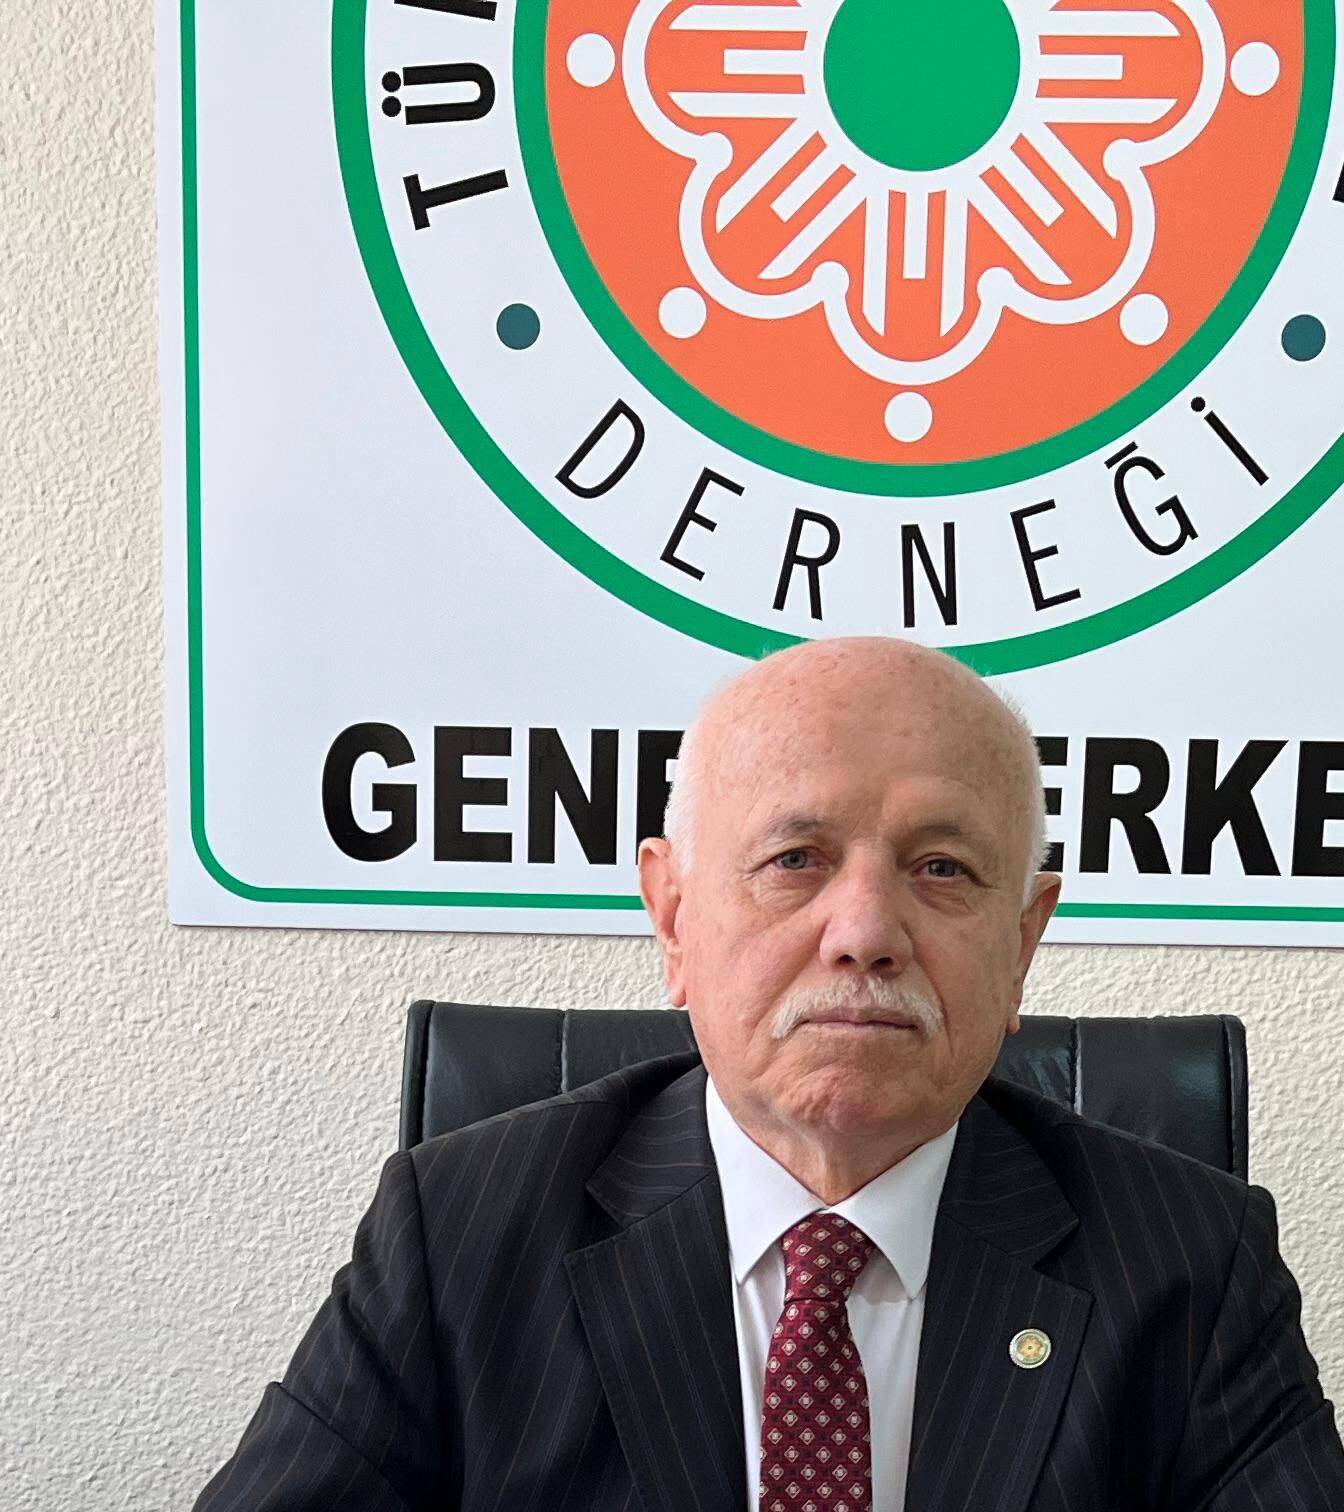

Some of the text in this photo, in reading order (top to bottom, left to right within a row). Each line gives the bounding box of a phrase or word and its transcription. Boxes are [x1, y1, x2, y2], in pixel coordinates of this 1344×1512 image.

[382, 0, 509, 231] TÜ
[555, 396, 1270, 629] DERNEĞİ
[321, 721, 685, 866] GEN
